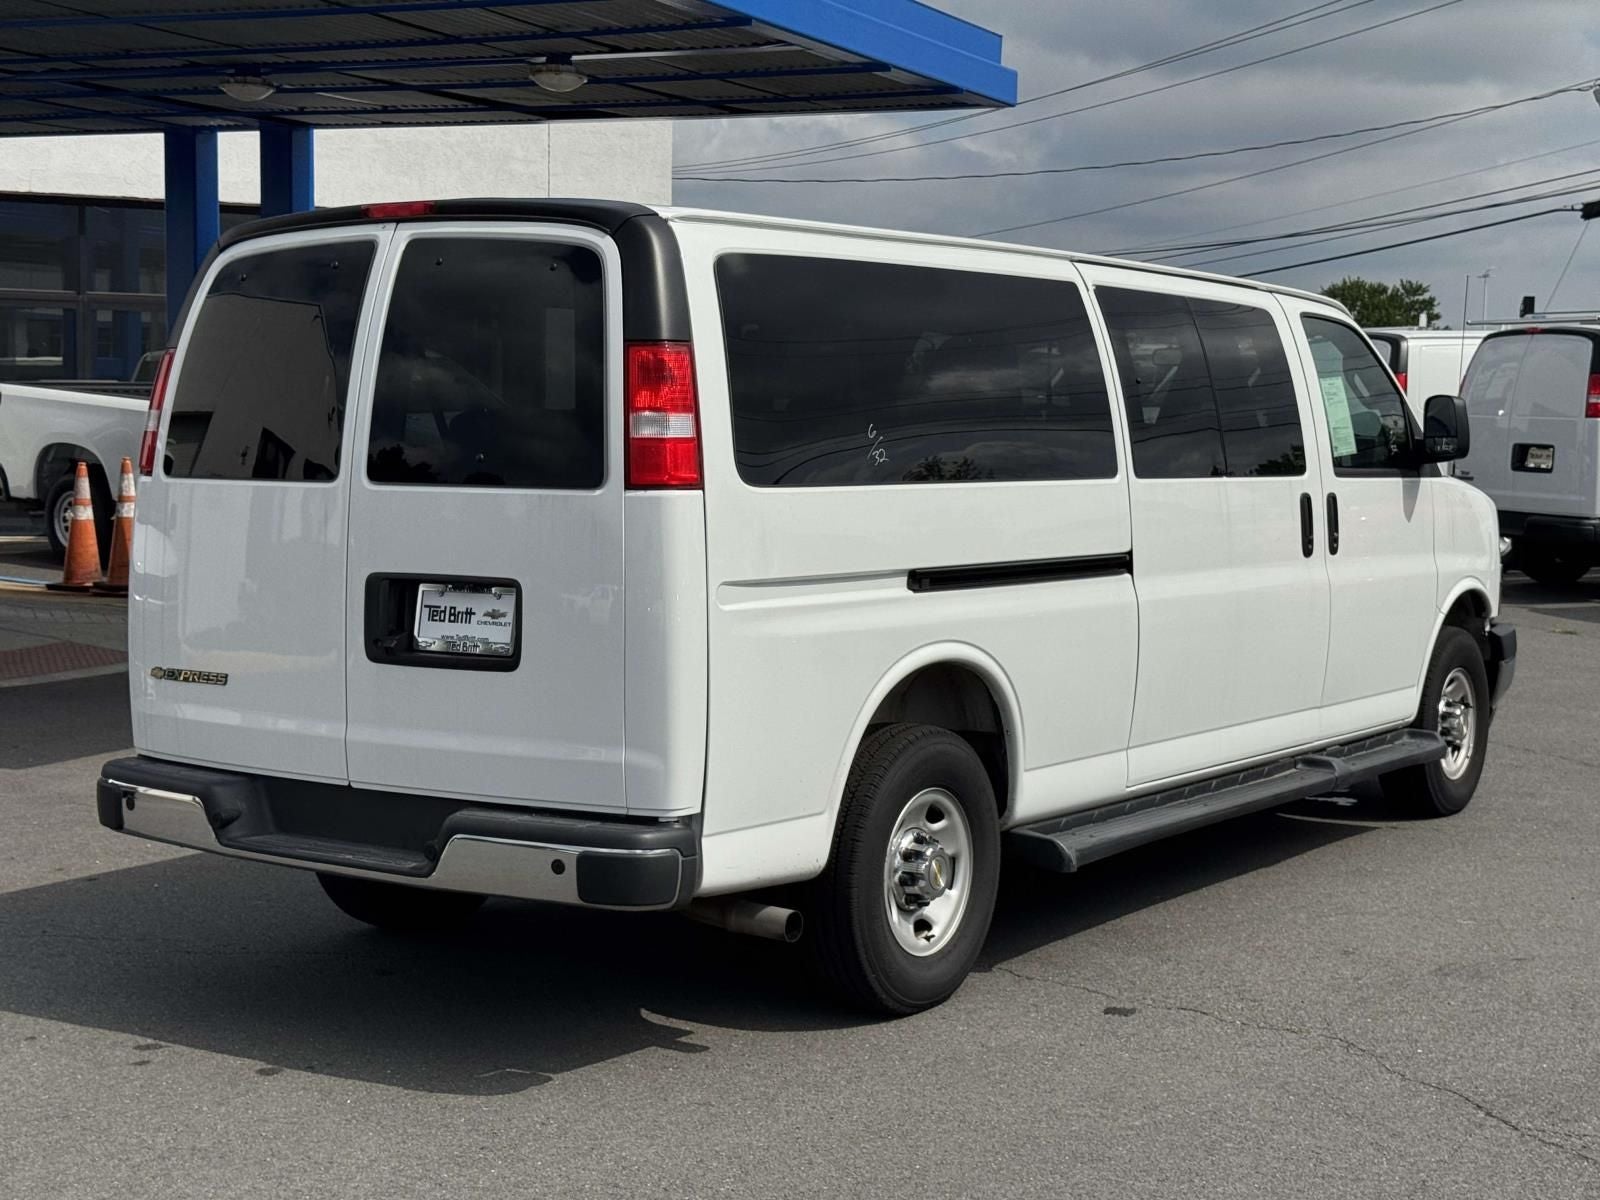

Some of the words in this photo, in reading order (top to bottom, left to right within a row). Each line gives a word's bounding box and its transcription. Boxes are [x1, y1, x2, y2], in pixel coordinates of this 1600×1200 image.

[424, 605, 447, 622] Ted
[448, 606, 476, 624] Britt
[165, 668, 228, 685] EXPRESS
